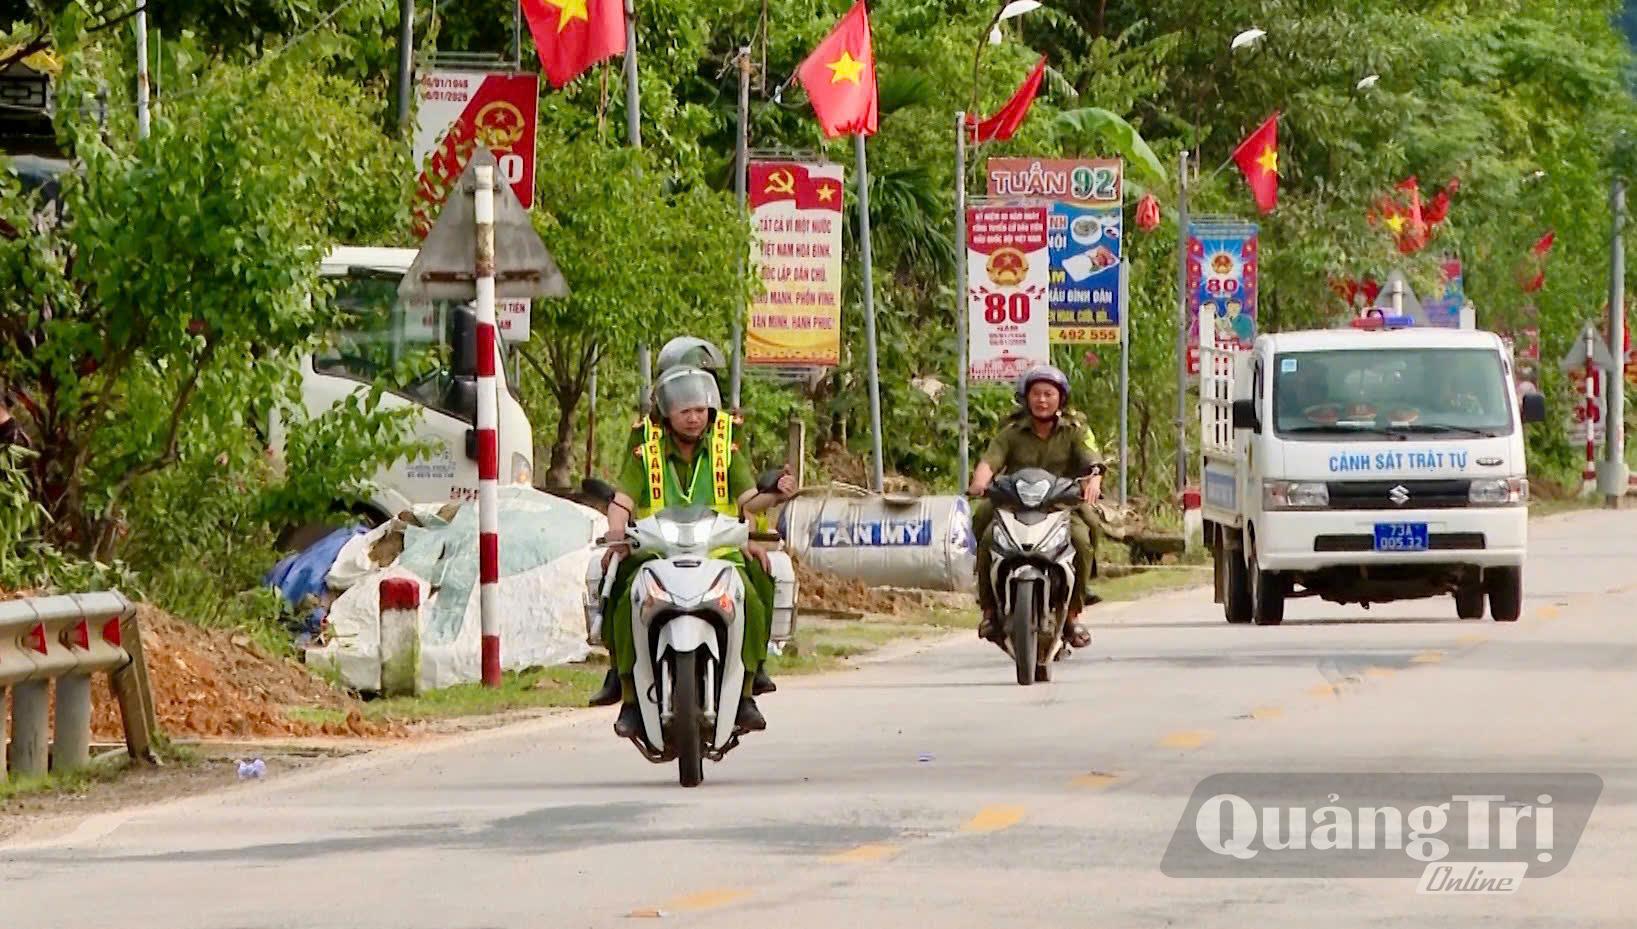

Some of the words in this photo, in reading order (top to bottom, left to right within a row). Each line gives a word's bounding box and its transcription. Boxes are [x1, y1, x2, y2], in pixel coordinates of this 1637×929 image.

[1071, 166, 1117, 199] 92
[1049, 215, 1068, 230] NH
[1207, 278, 1238, 294] 80
[984, 293, 1031, 324] 80
[1328, 452, 1370, 472] CẢNH
[1375, 450, 1403, 470] SÁT
[1408, 449, 1443, 472] TRẬT
[1391, 524, 1412, 536] 73A
